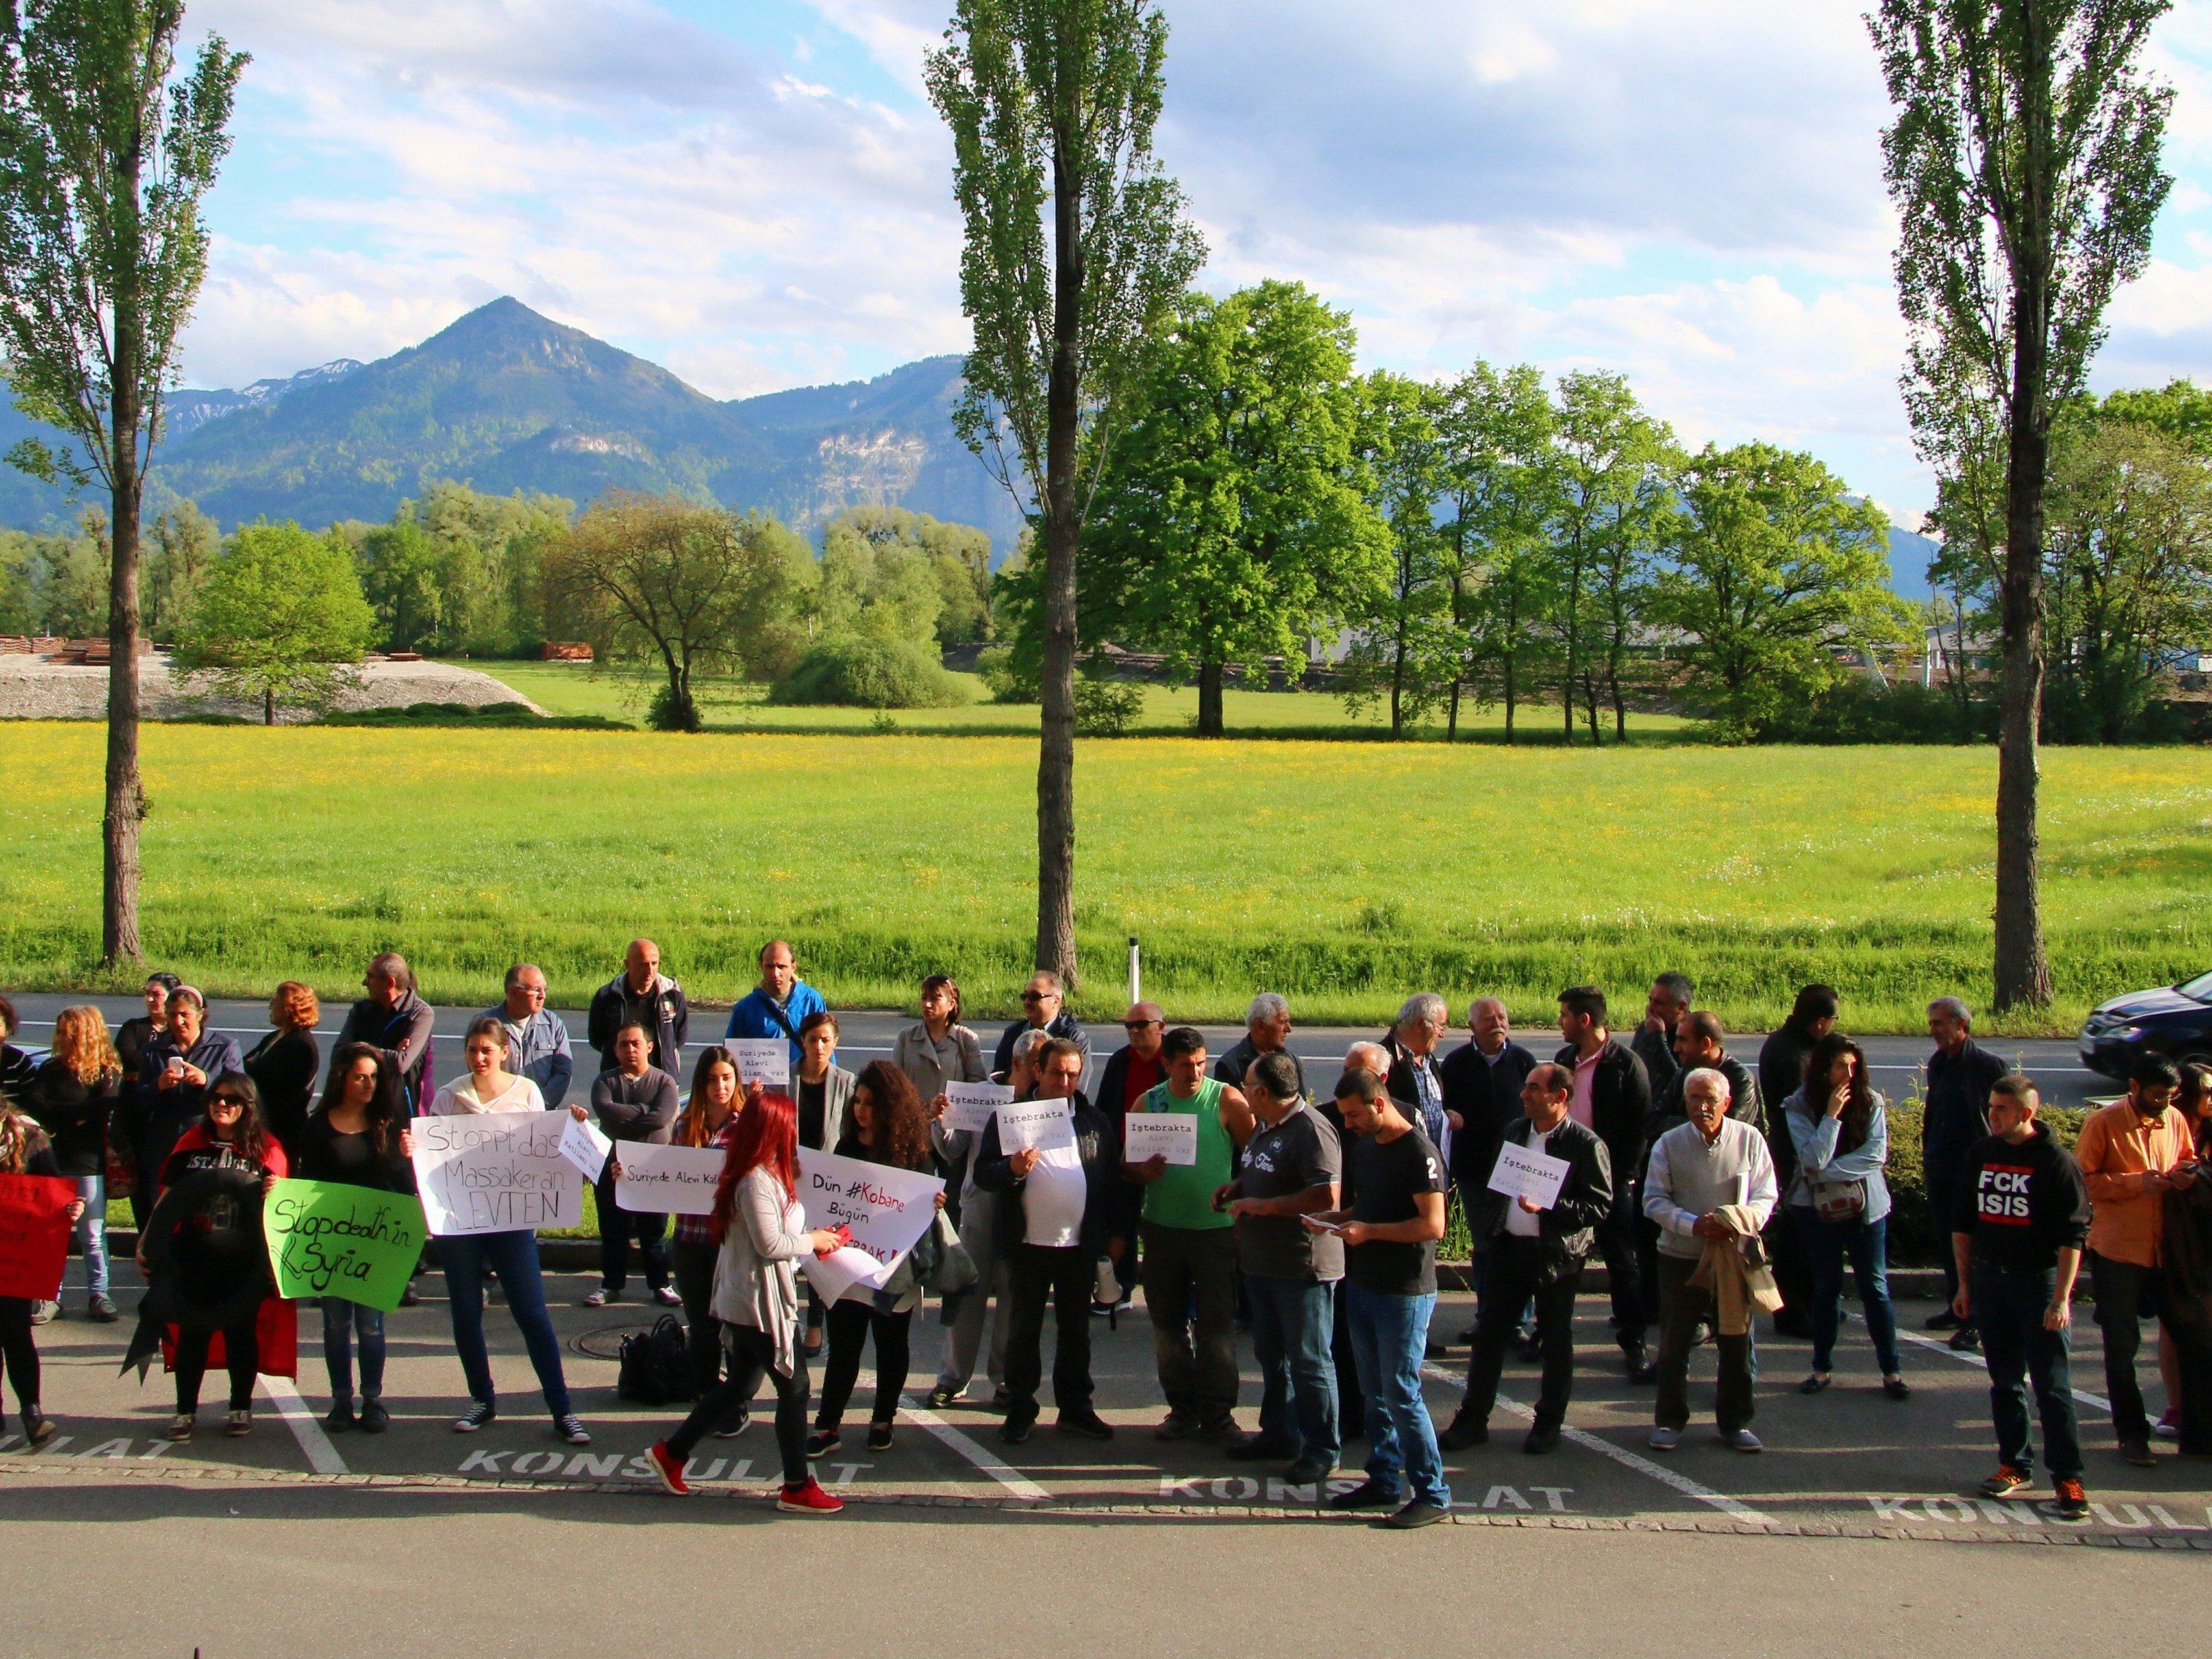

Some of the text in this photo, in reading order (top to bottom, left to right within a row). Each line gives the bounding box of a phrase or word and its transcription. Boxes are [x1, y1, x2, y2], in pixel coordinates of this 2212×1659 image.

[427, 1123, 562, 1159] Stoppt das
[1131, 1122, 1191, 1133] İştebrakta
[444, 1159, 566, 1190] Massaker an
[628, 1164, 670, 1187] Suriyede
[1426, 1157, 1438, 1180] 2
[1978, 1170, 2031, 1194] FCK
[813, 1173, 905, 1213] Dün #Kobane
[1978, 1192, 2029, 1217] ISIS
[301, 1241, 374, 1292] Syria
[1866, 1496, 2212, 1532] KONSUL
